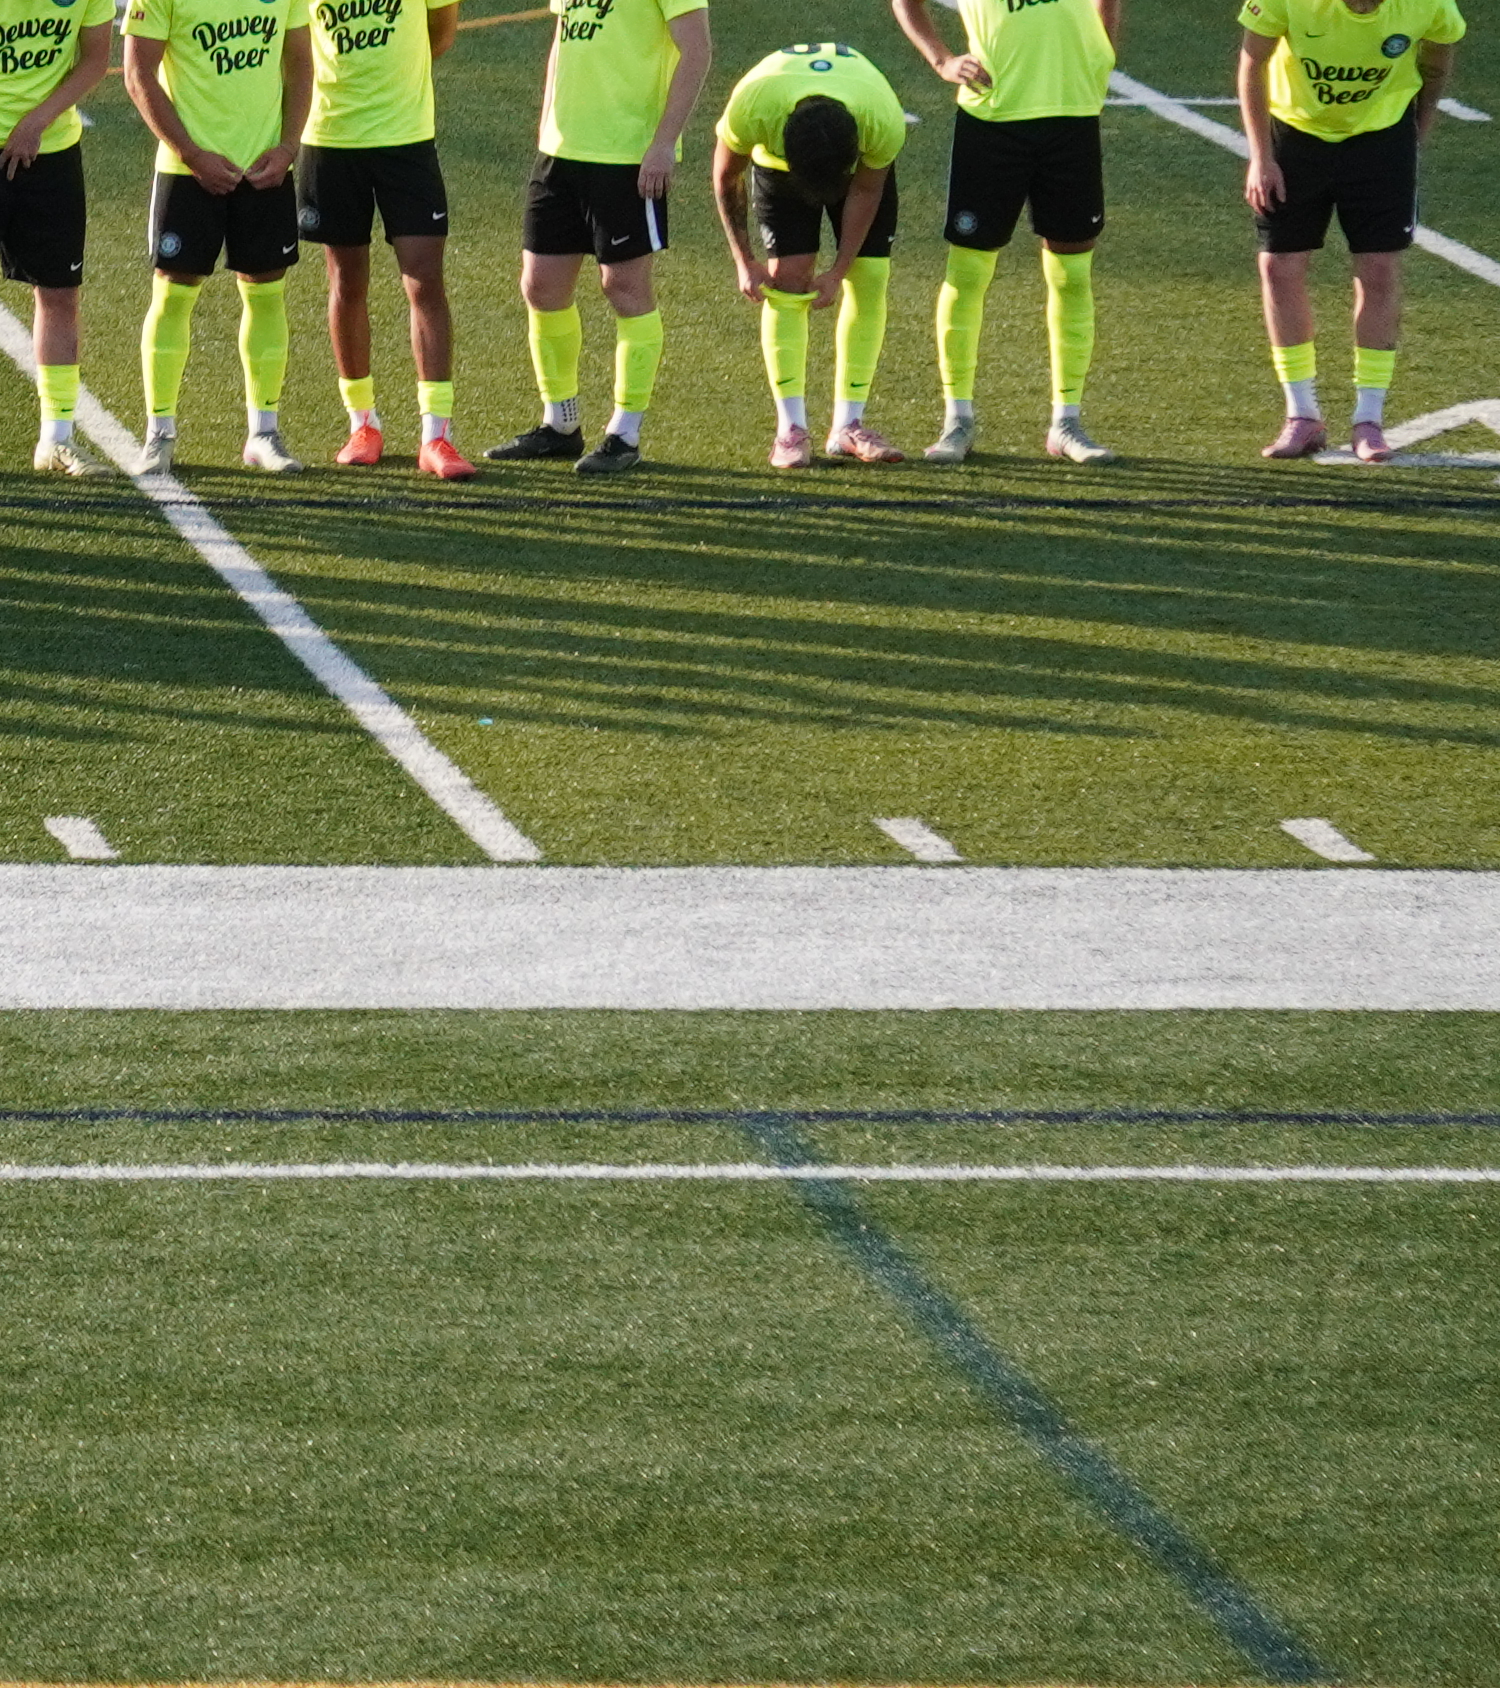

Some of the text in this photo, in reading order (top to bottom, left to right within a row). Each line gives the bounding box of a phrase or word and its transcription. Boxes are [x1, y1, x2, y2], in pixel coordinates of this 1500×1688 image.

[191, 14, 278, 52] Dewey
[332, 25, 396, 55] Beer
[209, 45, 271, 76] Beer
[1300, 57, 1394, 86] Dewey
[1312, 81, 1381, 106] Beer
